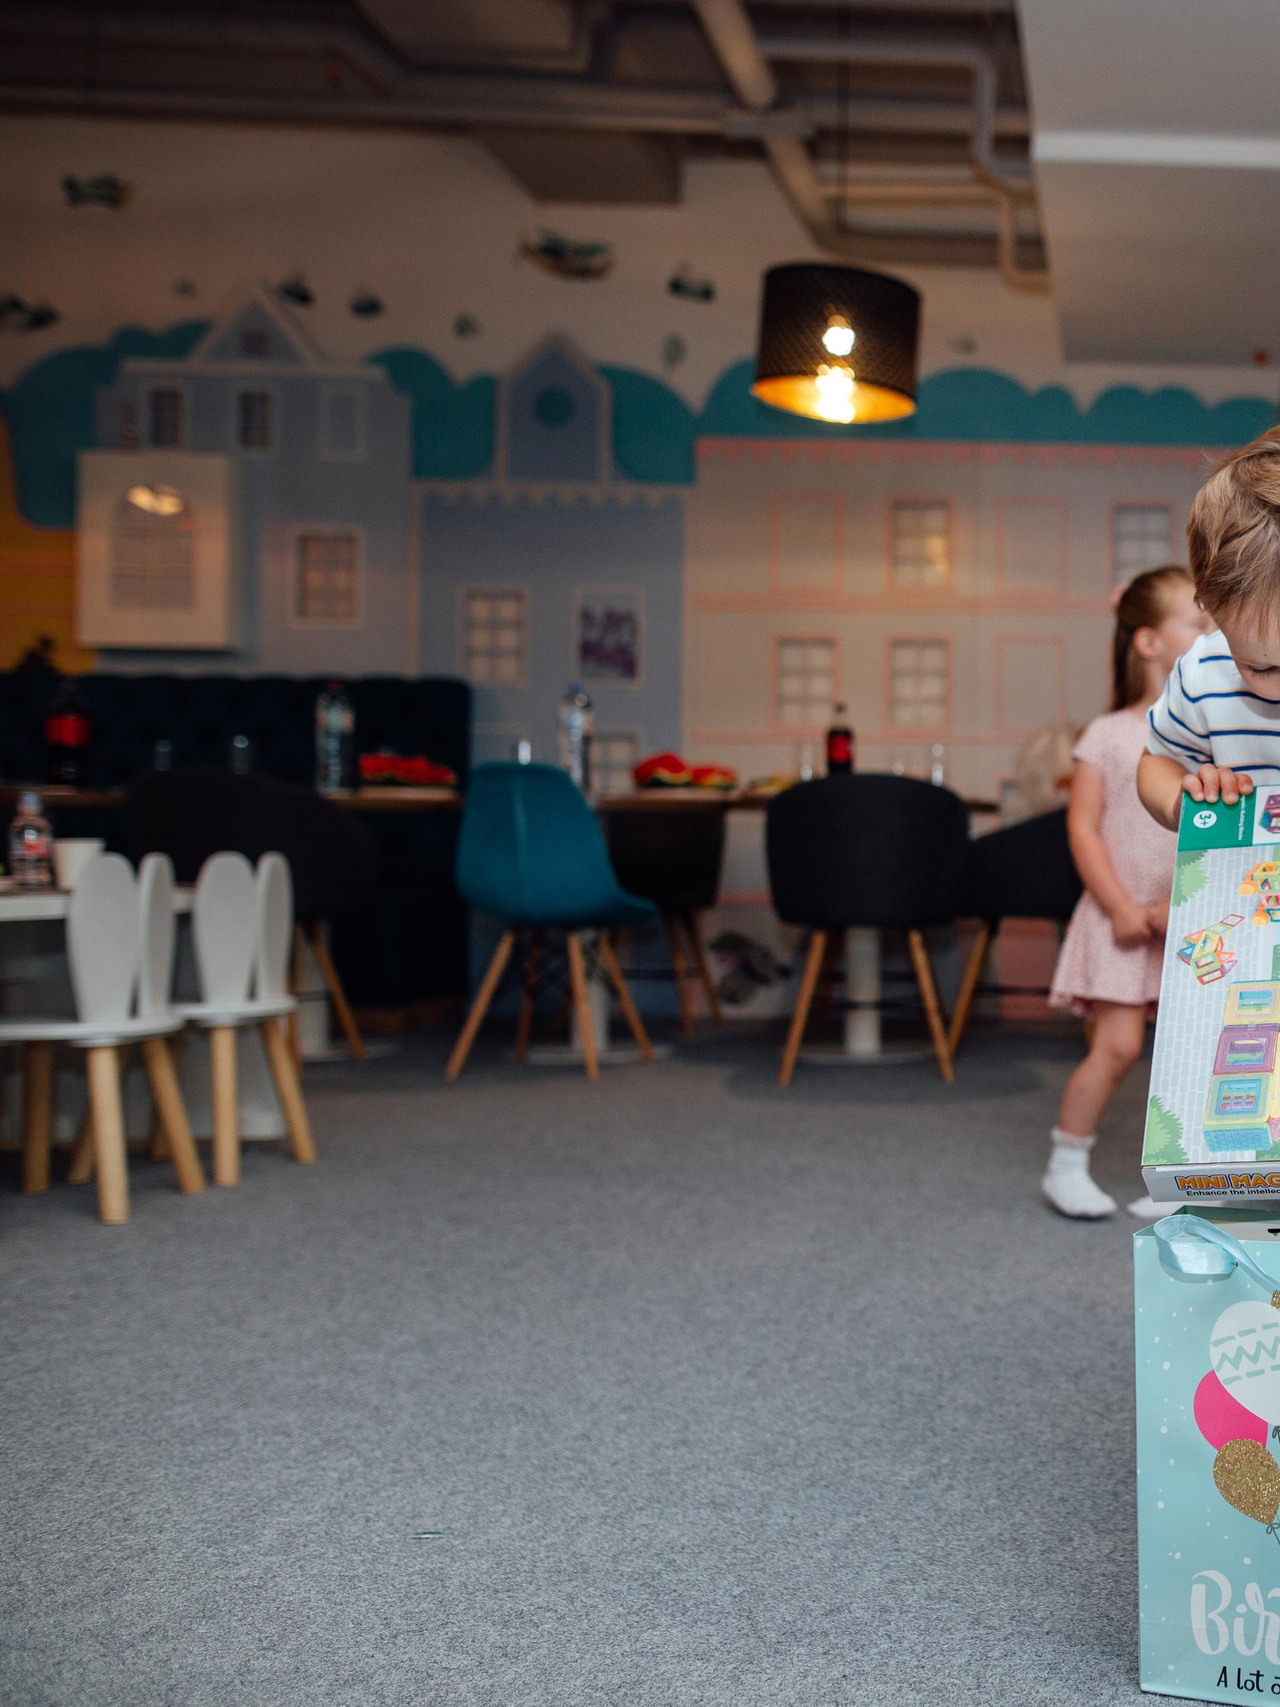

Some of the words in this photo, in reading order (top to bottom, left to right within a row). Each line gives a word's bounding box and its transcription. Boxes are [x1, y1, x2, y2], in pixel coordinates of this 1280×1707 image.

[1199, 813, 1212, 826] 3+
[1174, 1174, 1229, 1190] MINI
[1216, 1665, 1229, 1689] A
[1236, 1667, 1265, 1693] lot
